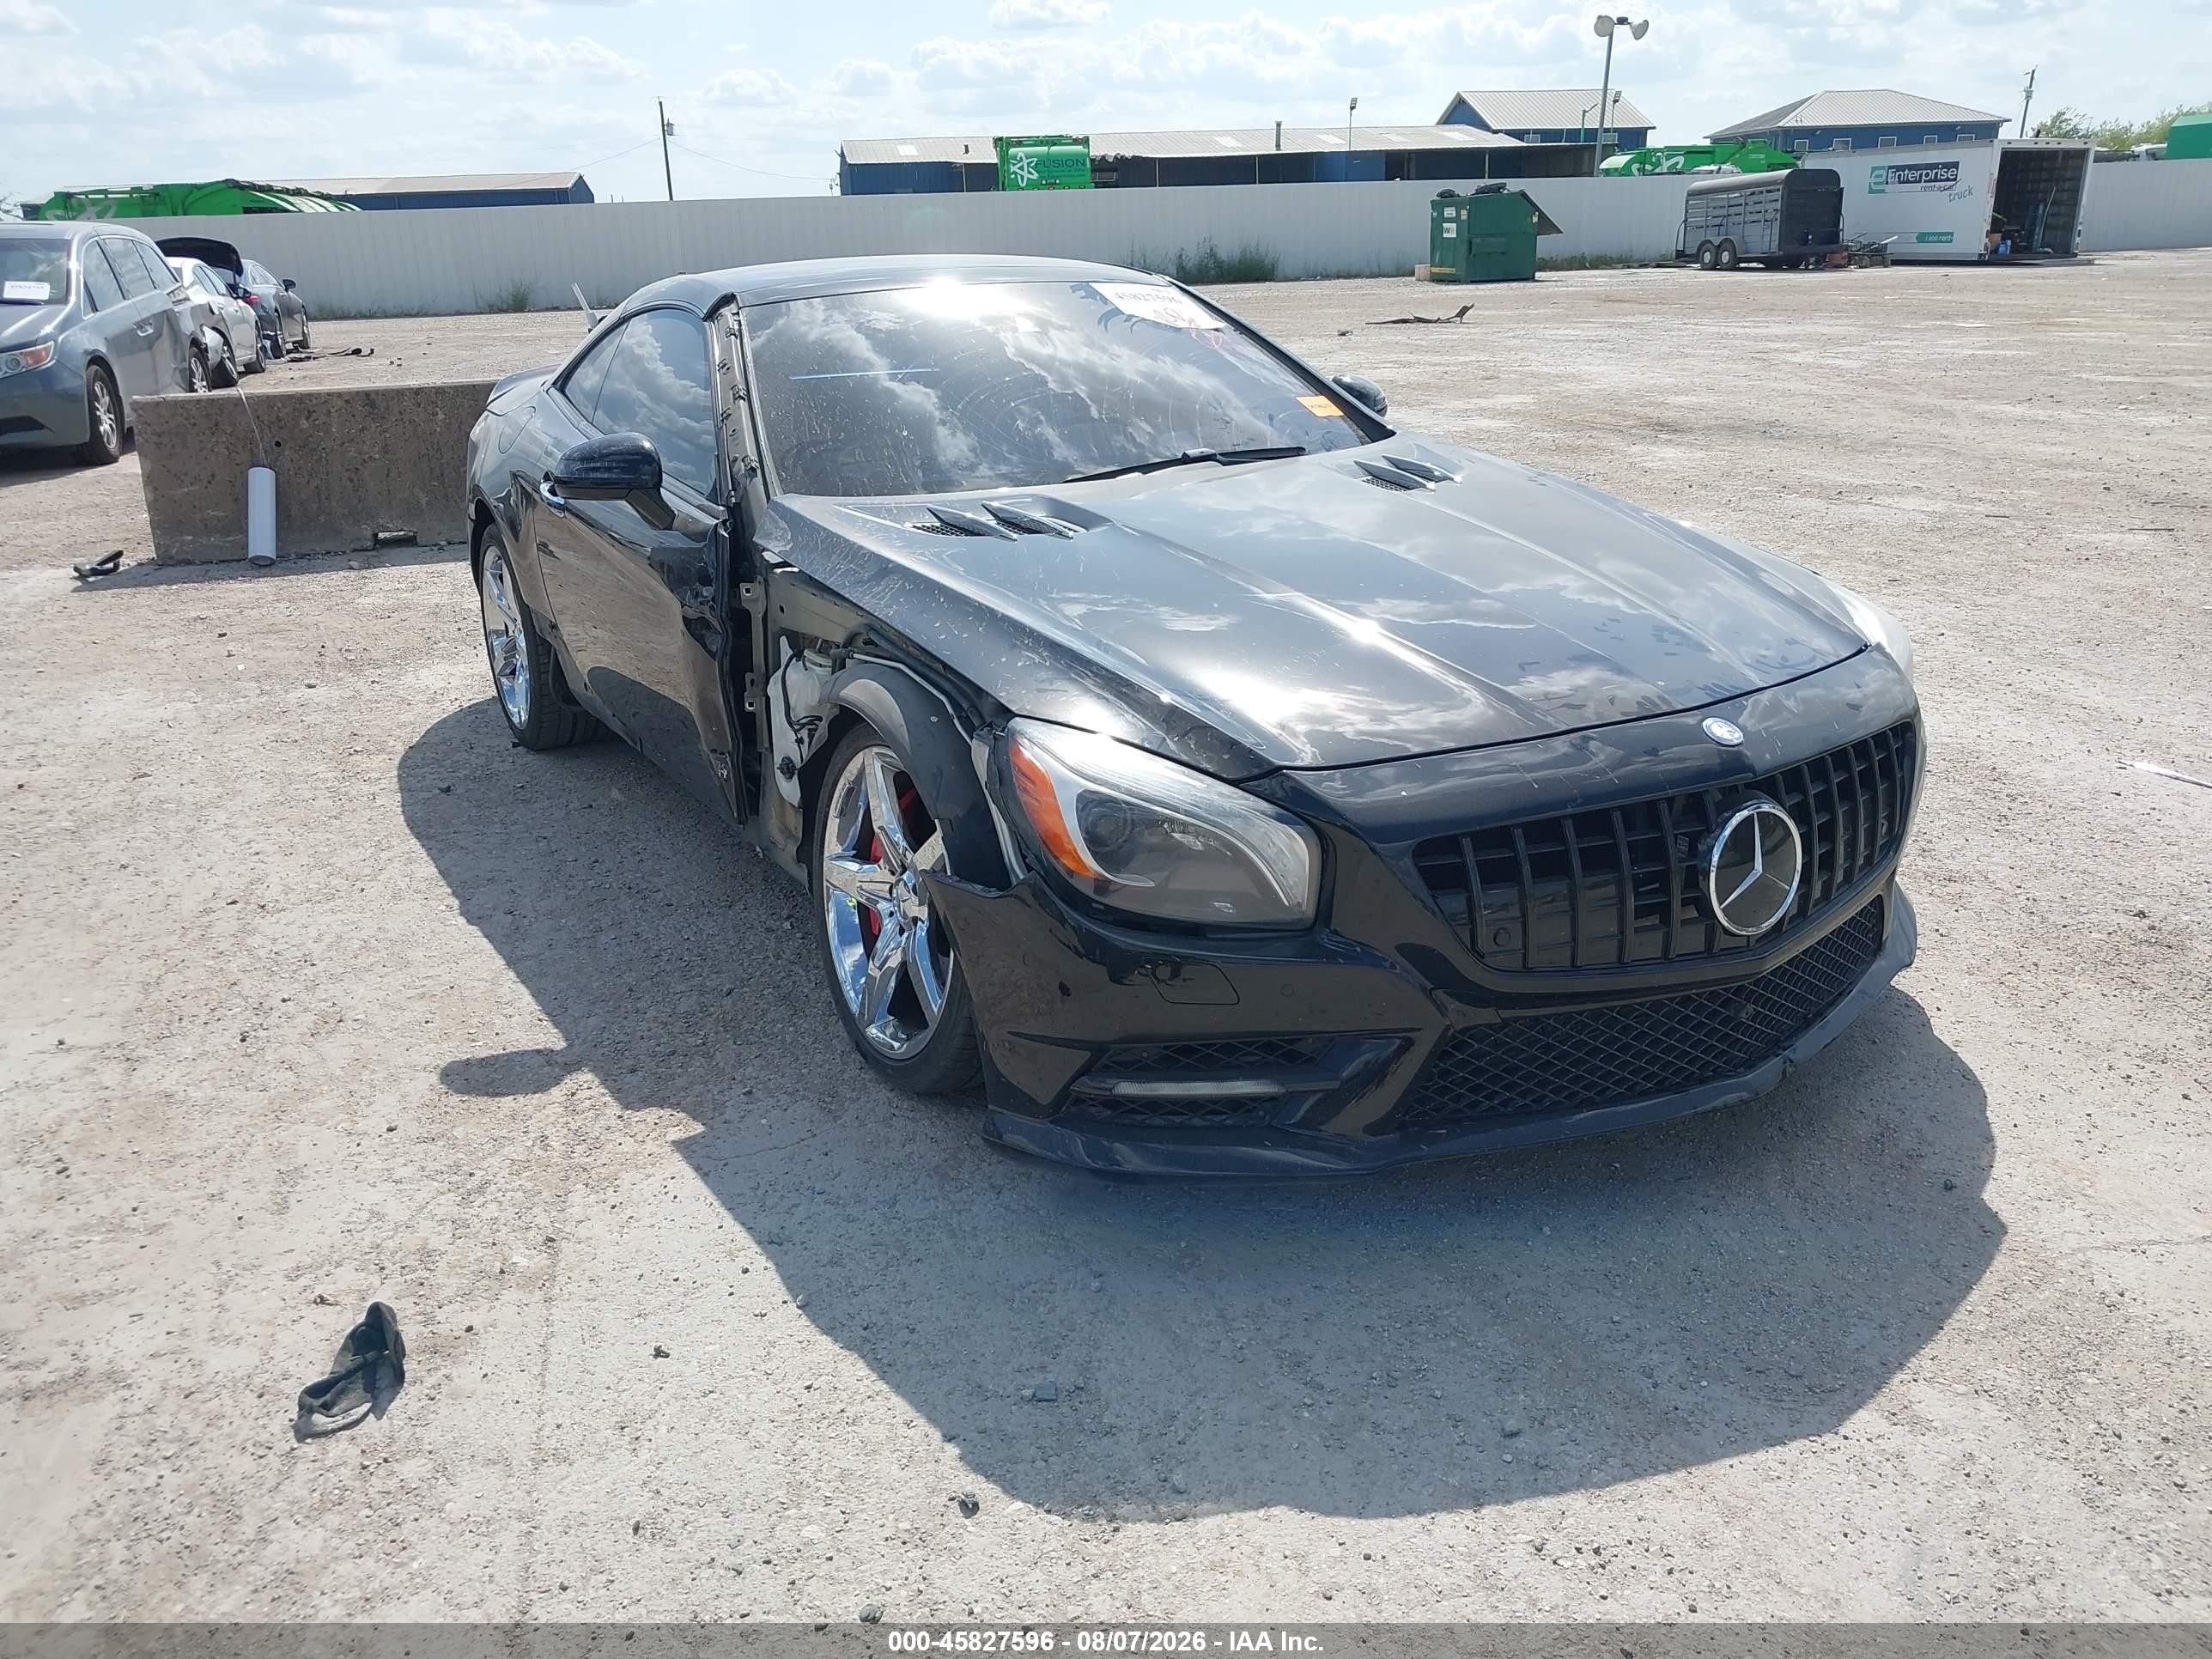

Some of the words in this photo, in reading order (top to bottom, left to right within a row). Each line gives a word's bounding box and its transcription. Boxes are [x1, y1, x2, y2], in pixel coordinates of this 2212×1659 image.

[1035, 158, 1085, 168] FUSION
[1887, 165, 1957, 184] Enterprise
[1948, 185, 1974, 203] truck
